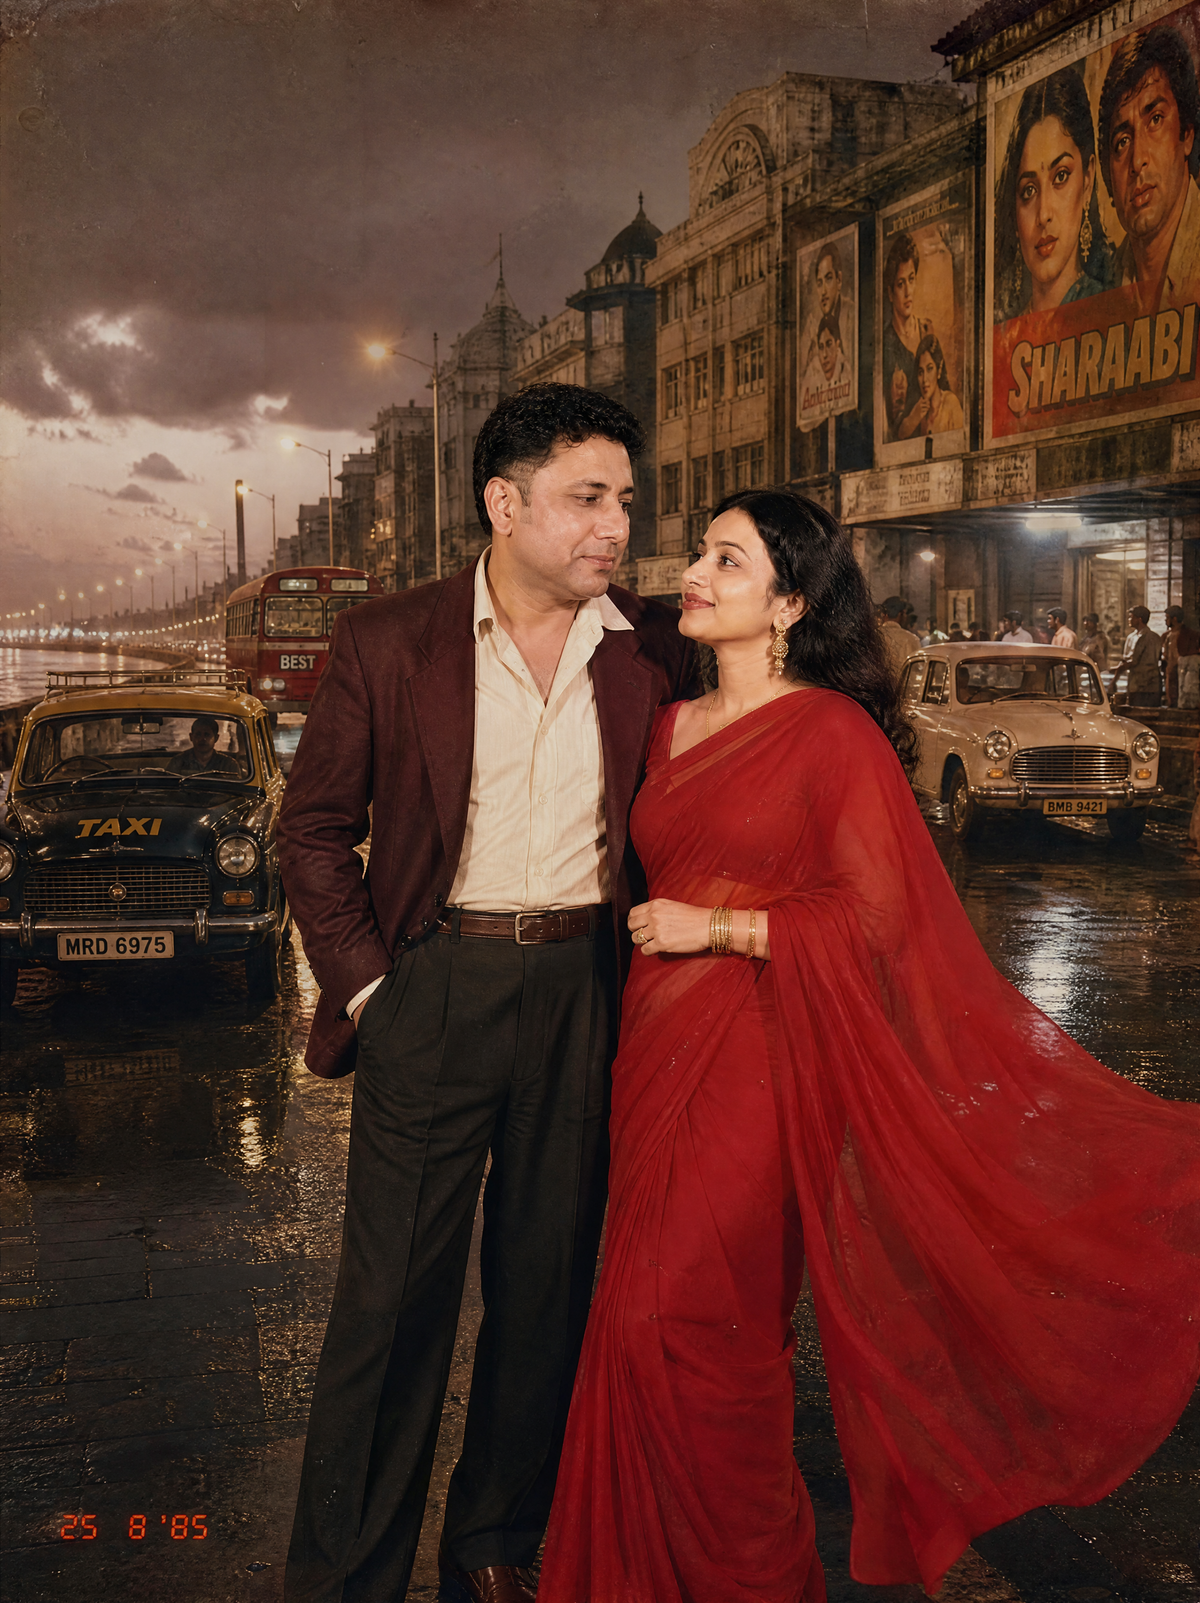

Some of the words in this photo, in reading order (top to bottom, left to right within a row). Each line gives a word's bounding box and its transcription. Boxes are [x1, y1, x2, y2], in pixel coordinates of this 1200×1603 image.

[1008, 302, 1199, 416] SHARAABI
[280, 654, 317, 670] BEST
[1048, 801, 1073, 812] BMB
[1076, 801, 1103, 812] 9421
[77, 817, 163, 838] TAXI
[65, 938, 108, 955] MRD
[116, 936, 166, 954] 6975
